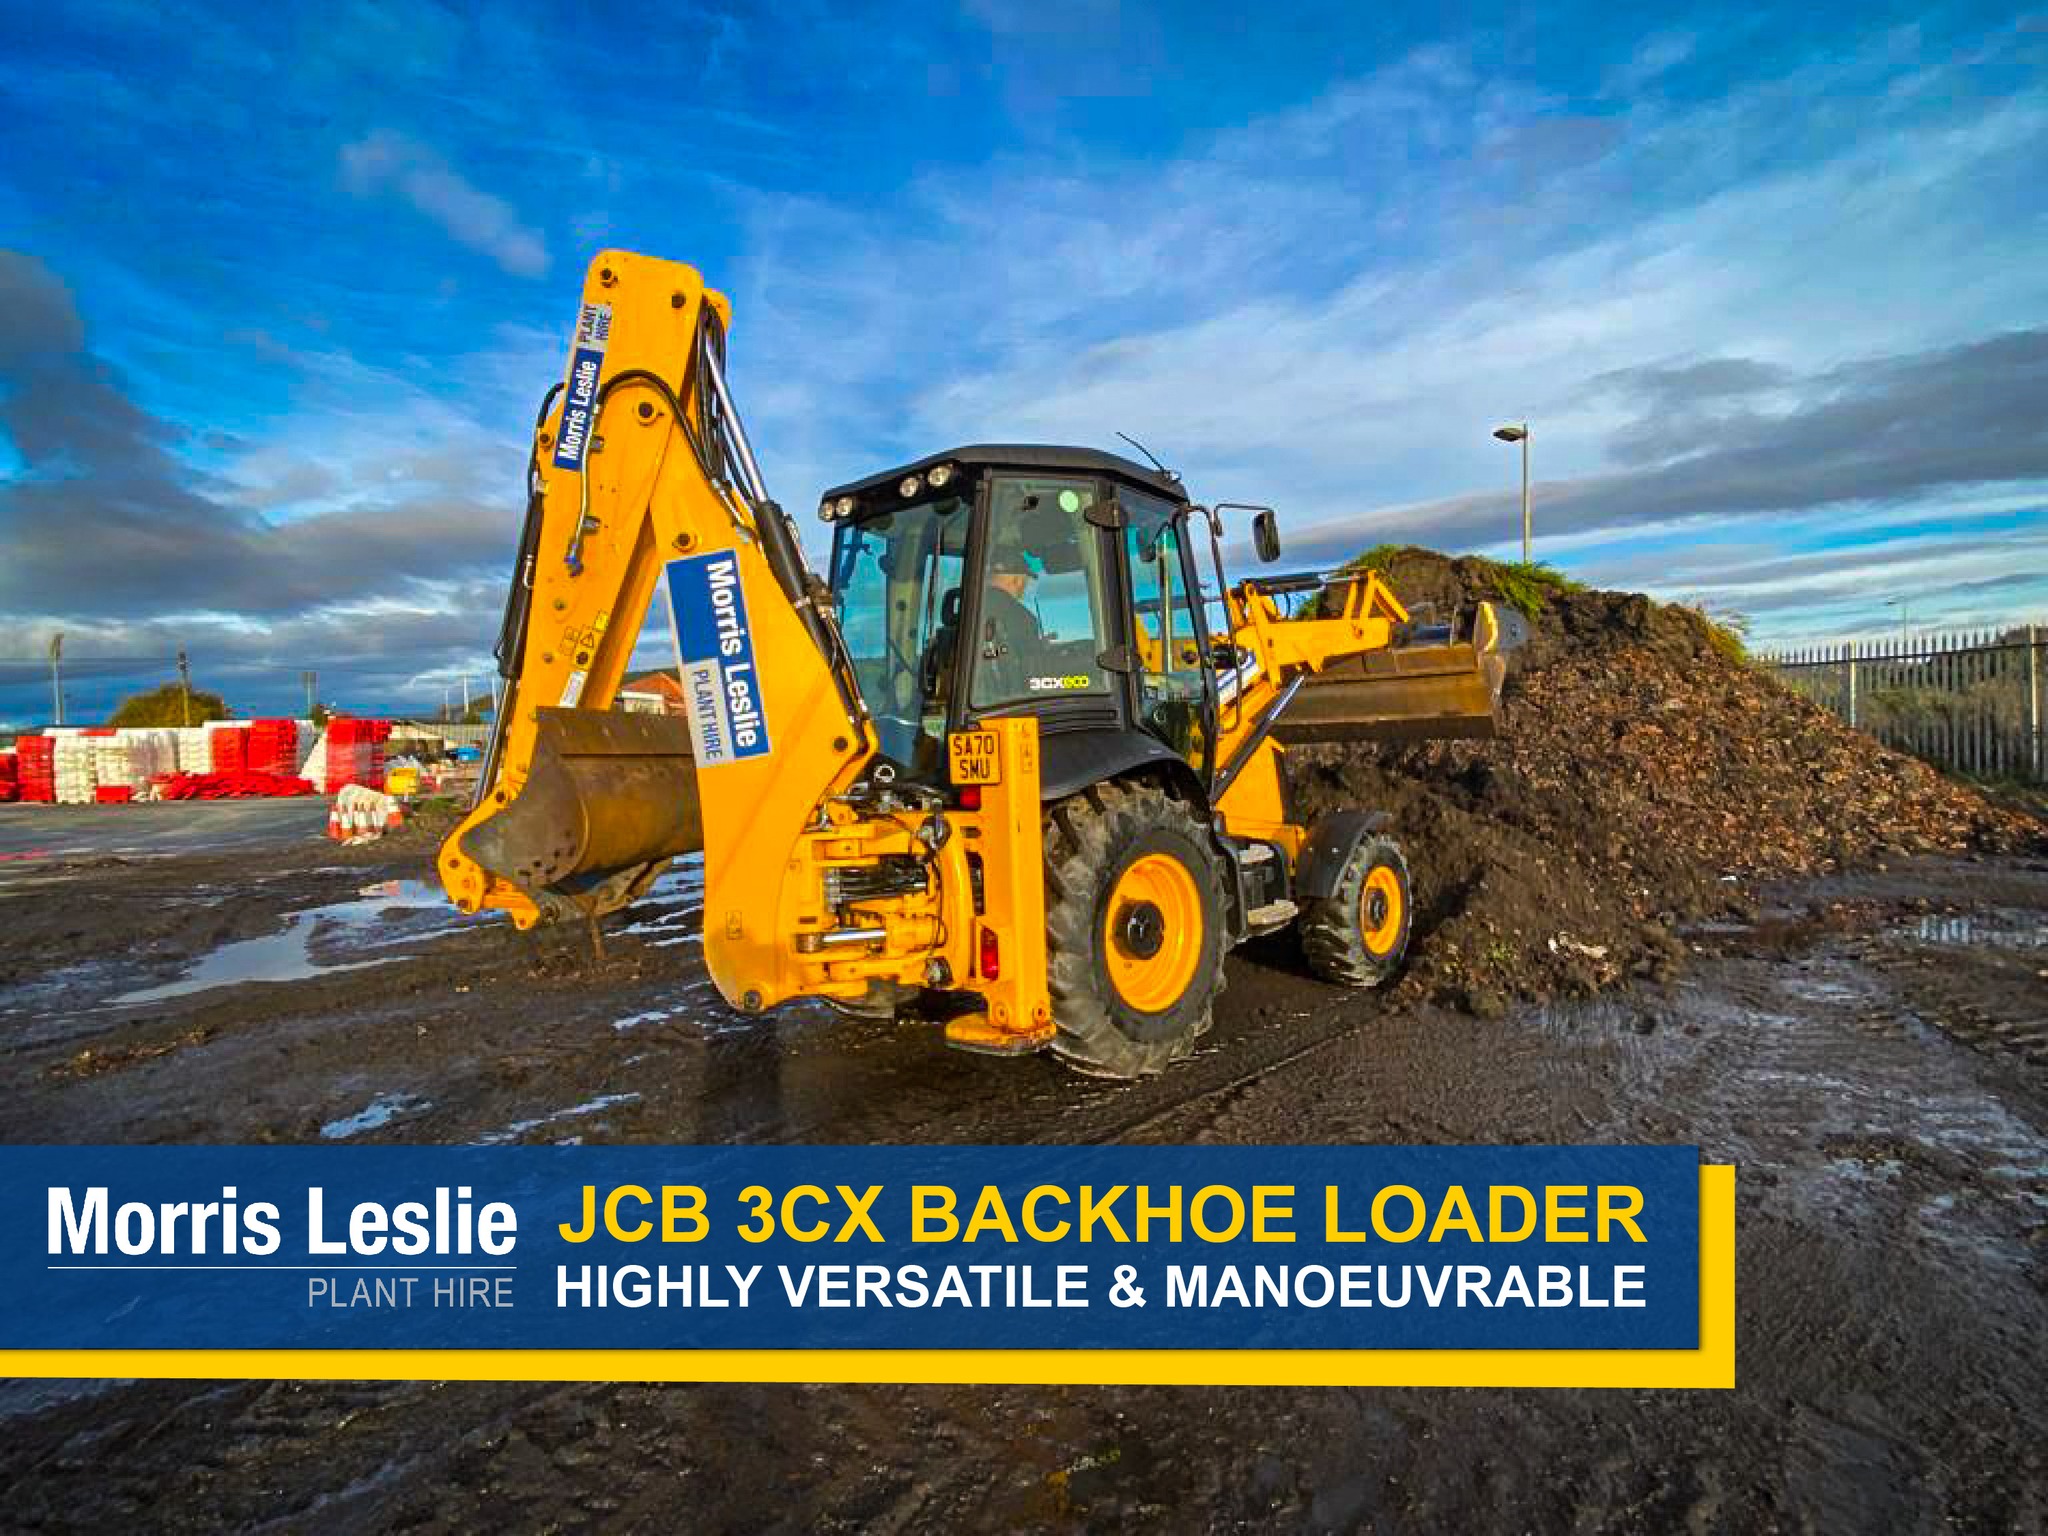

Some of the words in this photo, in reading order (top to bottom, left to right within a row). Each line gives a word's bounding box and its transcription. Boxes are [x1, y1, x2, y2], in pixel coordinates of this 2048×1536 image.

[579, 304, 596, 343] PLANT
[595, 312, 612, 341] HIRE
[570, 361, 597, 407] Leslie
[557, 409, 586, 460] Morris
[707, 559, 747, 657] Morris
[693, 669, 717, 720] PLANT
[725, 663, 761, 748] Leslie
[702, 722, 723, 760] HIRE
[953, 735, 995, 756] SA70
[959, 758, 991, 779] SMU
